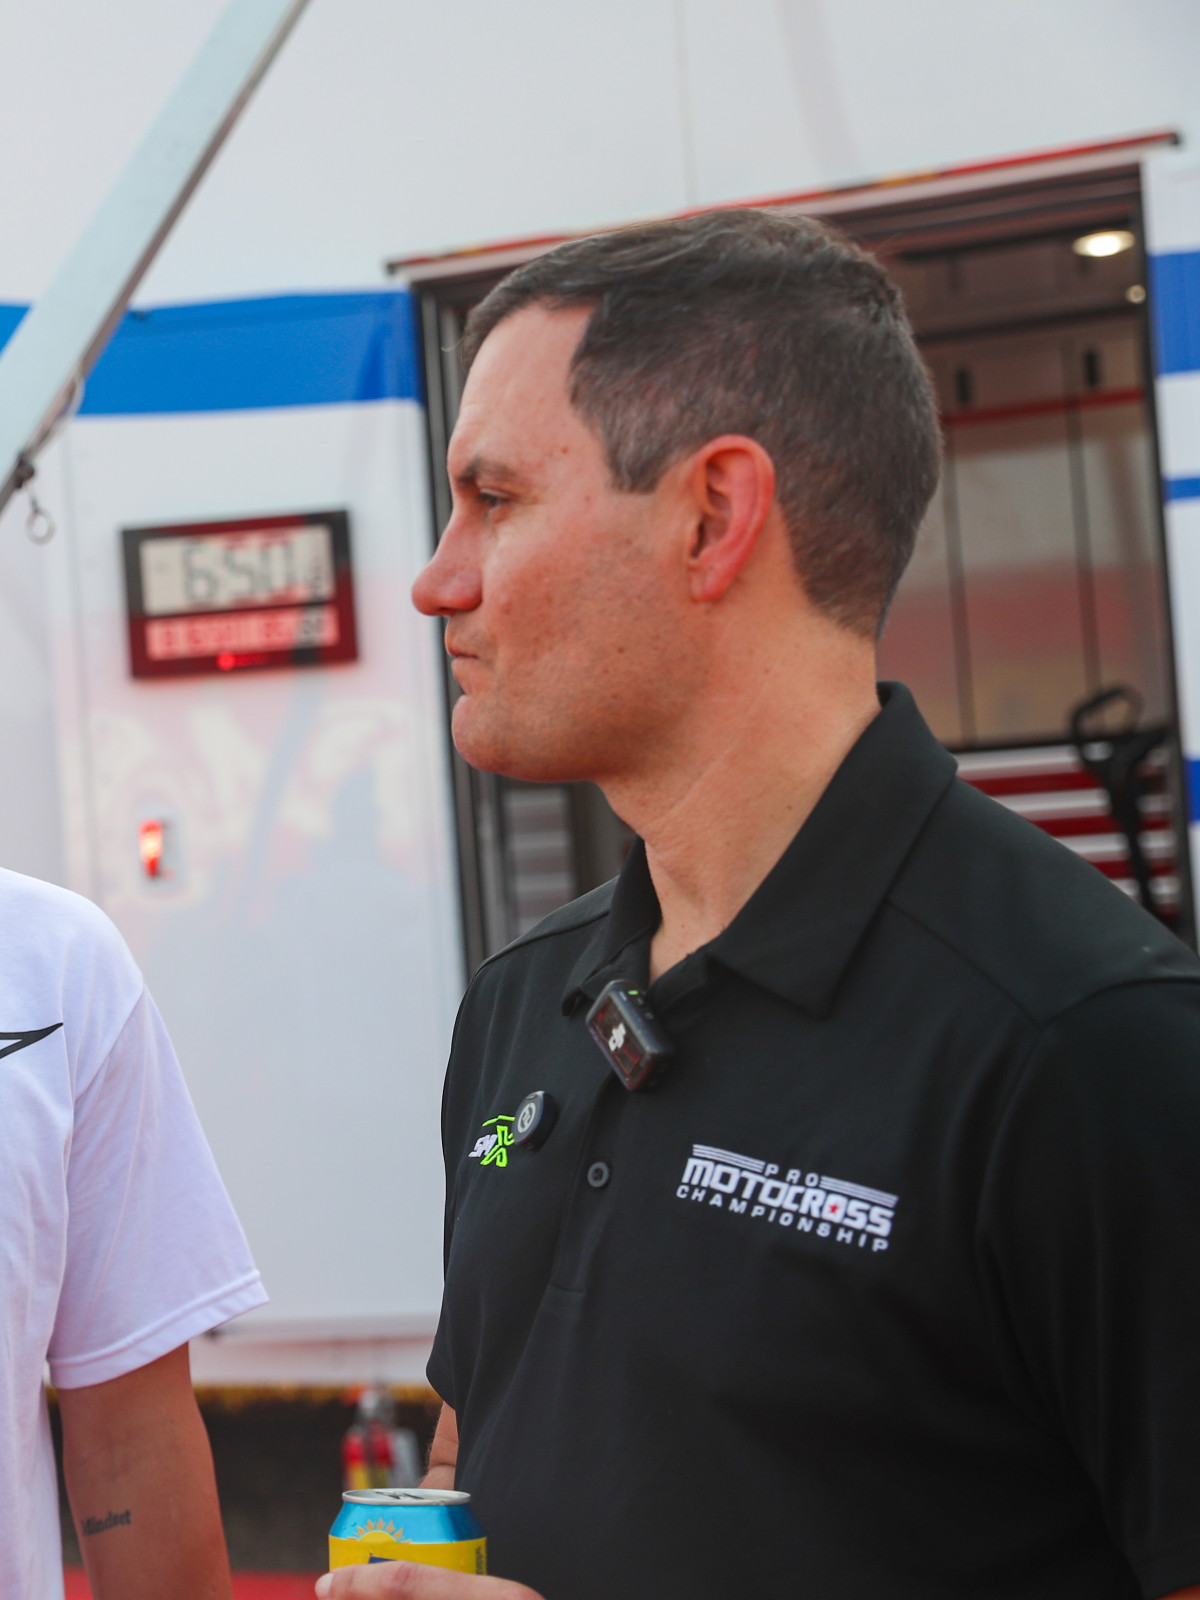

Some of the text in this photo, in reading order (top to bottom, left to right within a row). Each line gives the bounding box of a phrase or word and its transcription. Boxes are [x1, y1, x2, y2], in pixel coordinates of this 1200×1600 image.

[681, 1157, 895, 1237] MOTOCROSS
[765, 1163, 820, 1188] PRO
[676, 1184, 889, 1252] CHAMPIONSHIP
